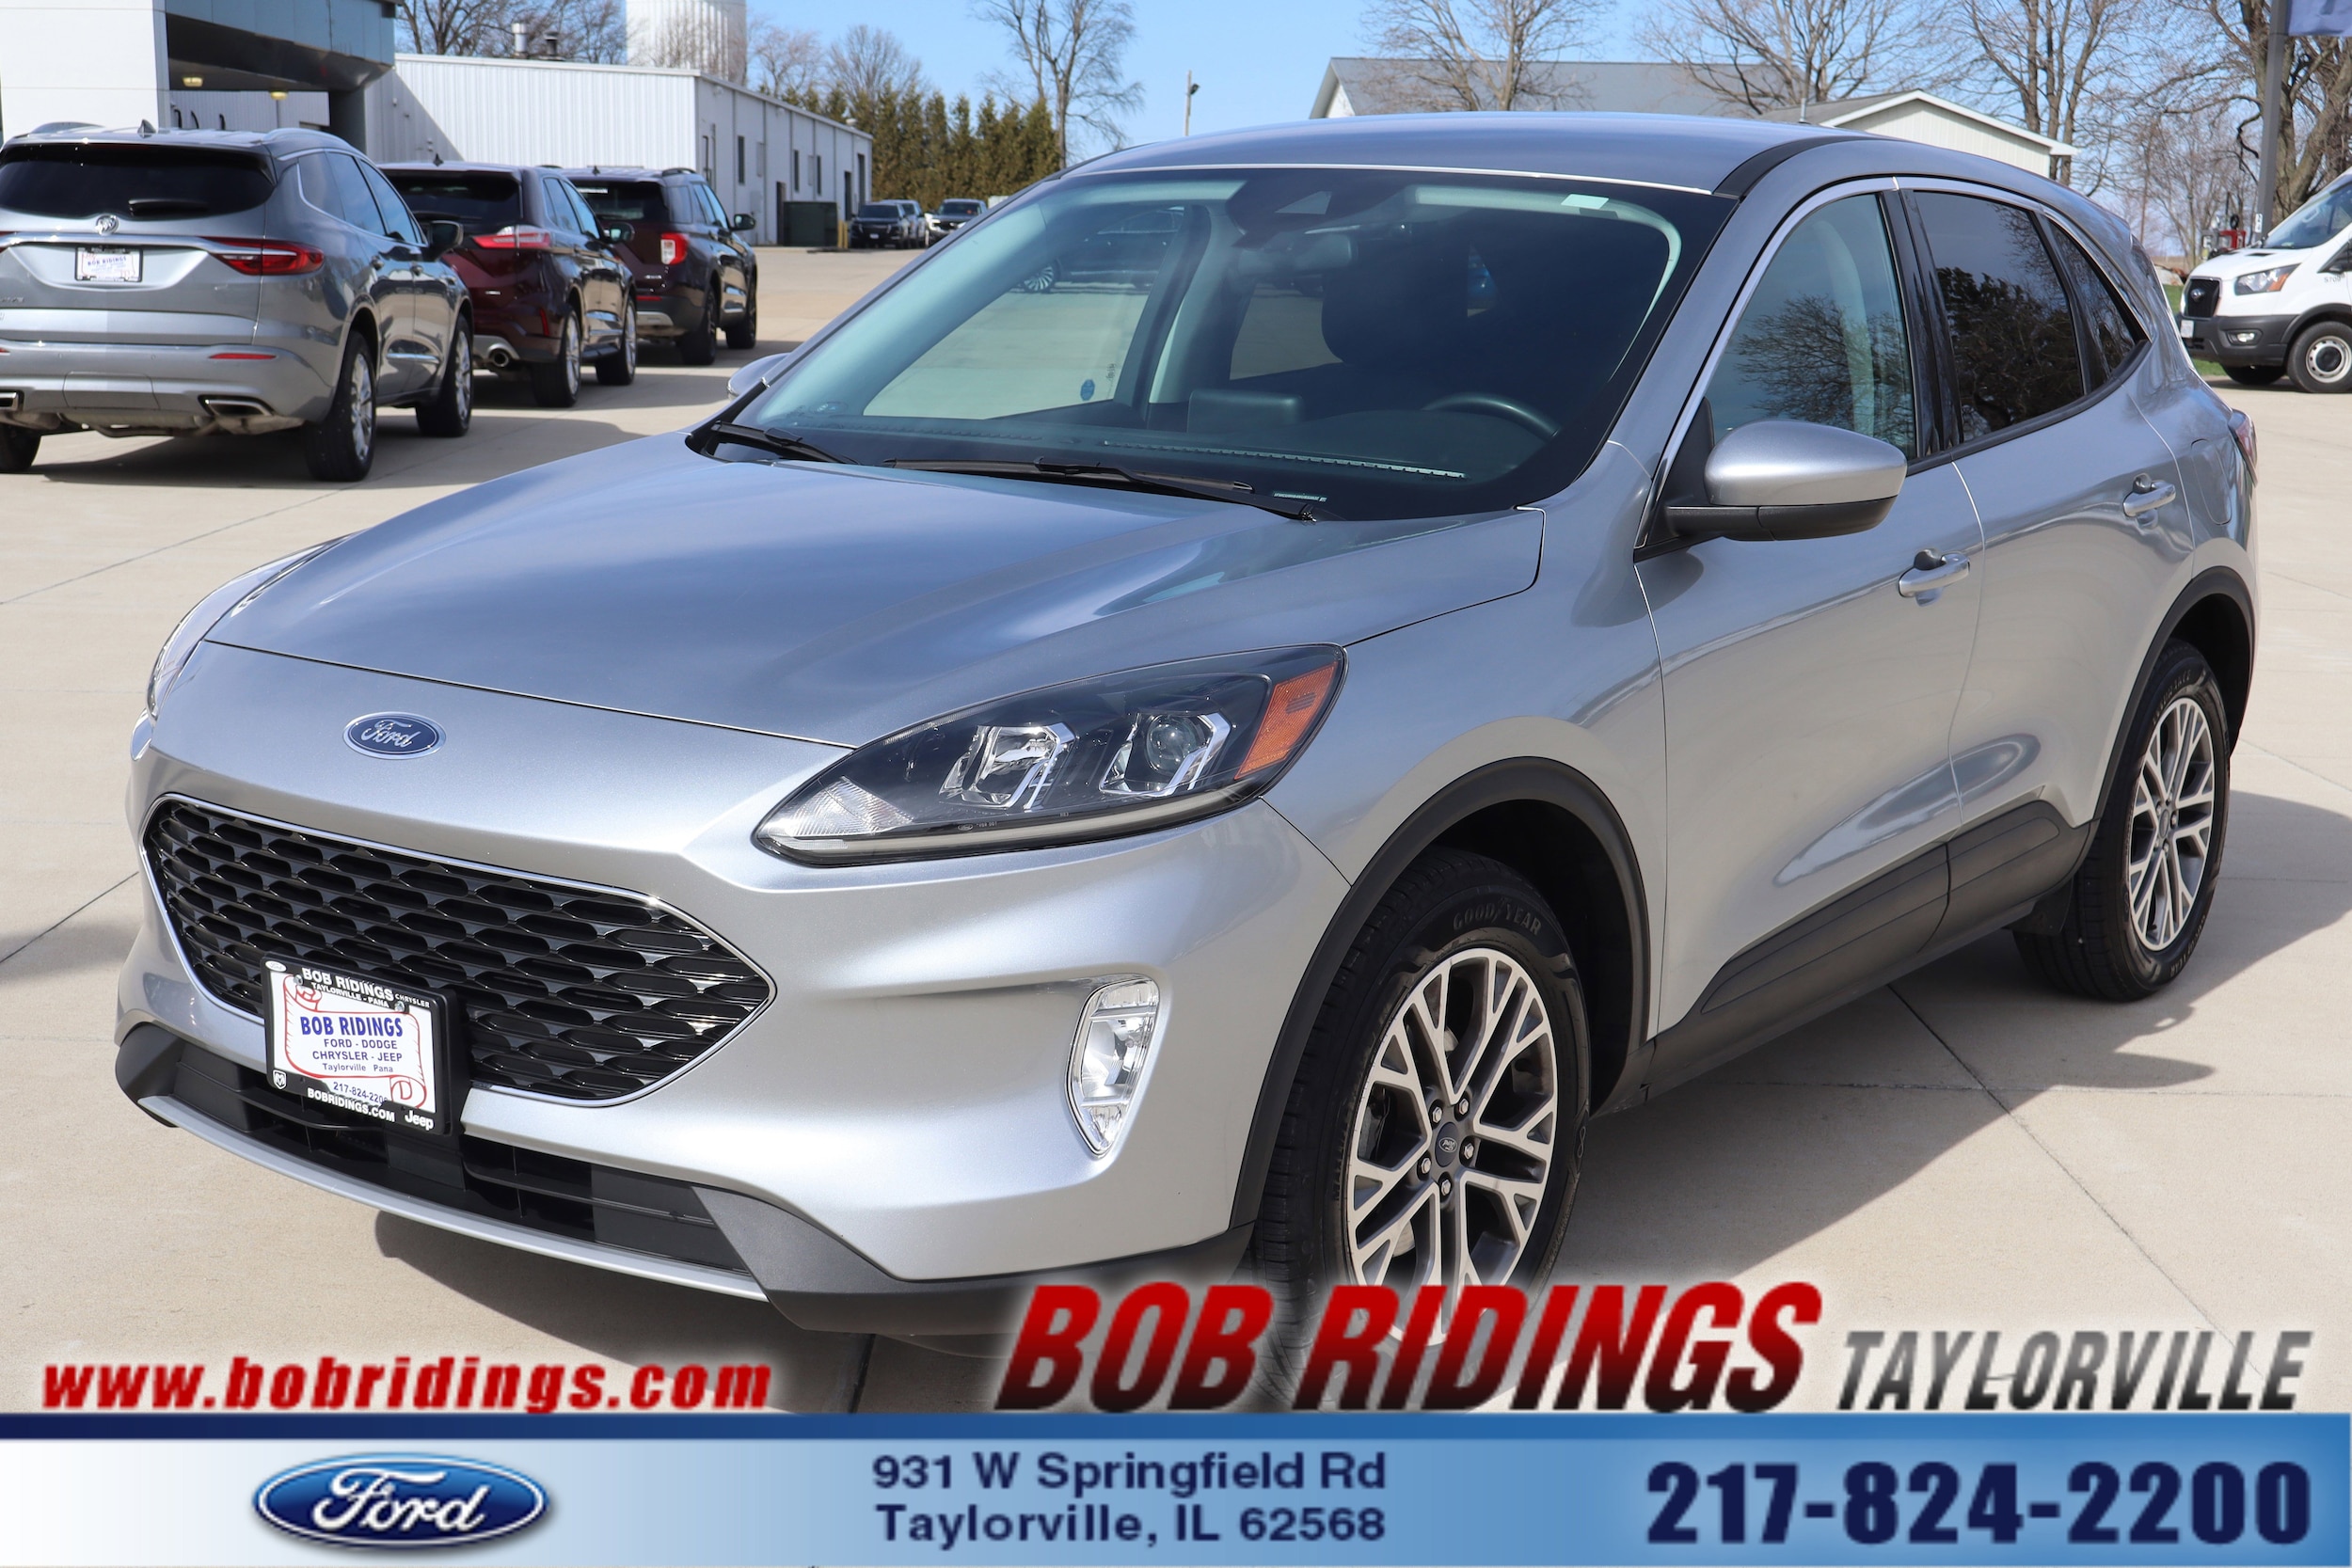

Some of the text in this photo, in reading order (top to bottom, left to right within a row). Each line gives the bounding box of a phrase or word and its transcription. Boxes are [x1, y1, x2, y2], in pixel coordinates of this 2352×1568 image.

[360, 720, 421, 748] Ford
[301, 967, 394, 1002] BOB RIDINGS
[311, 982, 362, 1002] TAYLORVILLE
[368, 997, 390, 1008] PANA
[395, 993, 430, 1008] CHRYSLER
[300, 1016, 404, 1037] BOB RIDINGS
[324, 1038, 353, 1049] FORD
[361, 1039, 398, 1050] DODGE
[312, 1051, 368, 1061] CHRYSLER
[377, 1052, 403, 1062] JEEP
[323, 1063, 394, 1073] Taylorville Pana
[307, 1087, 395, 1123] BOBRIDINGS.COM
[405, 1110, 434, 1131] Jeep
